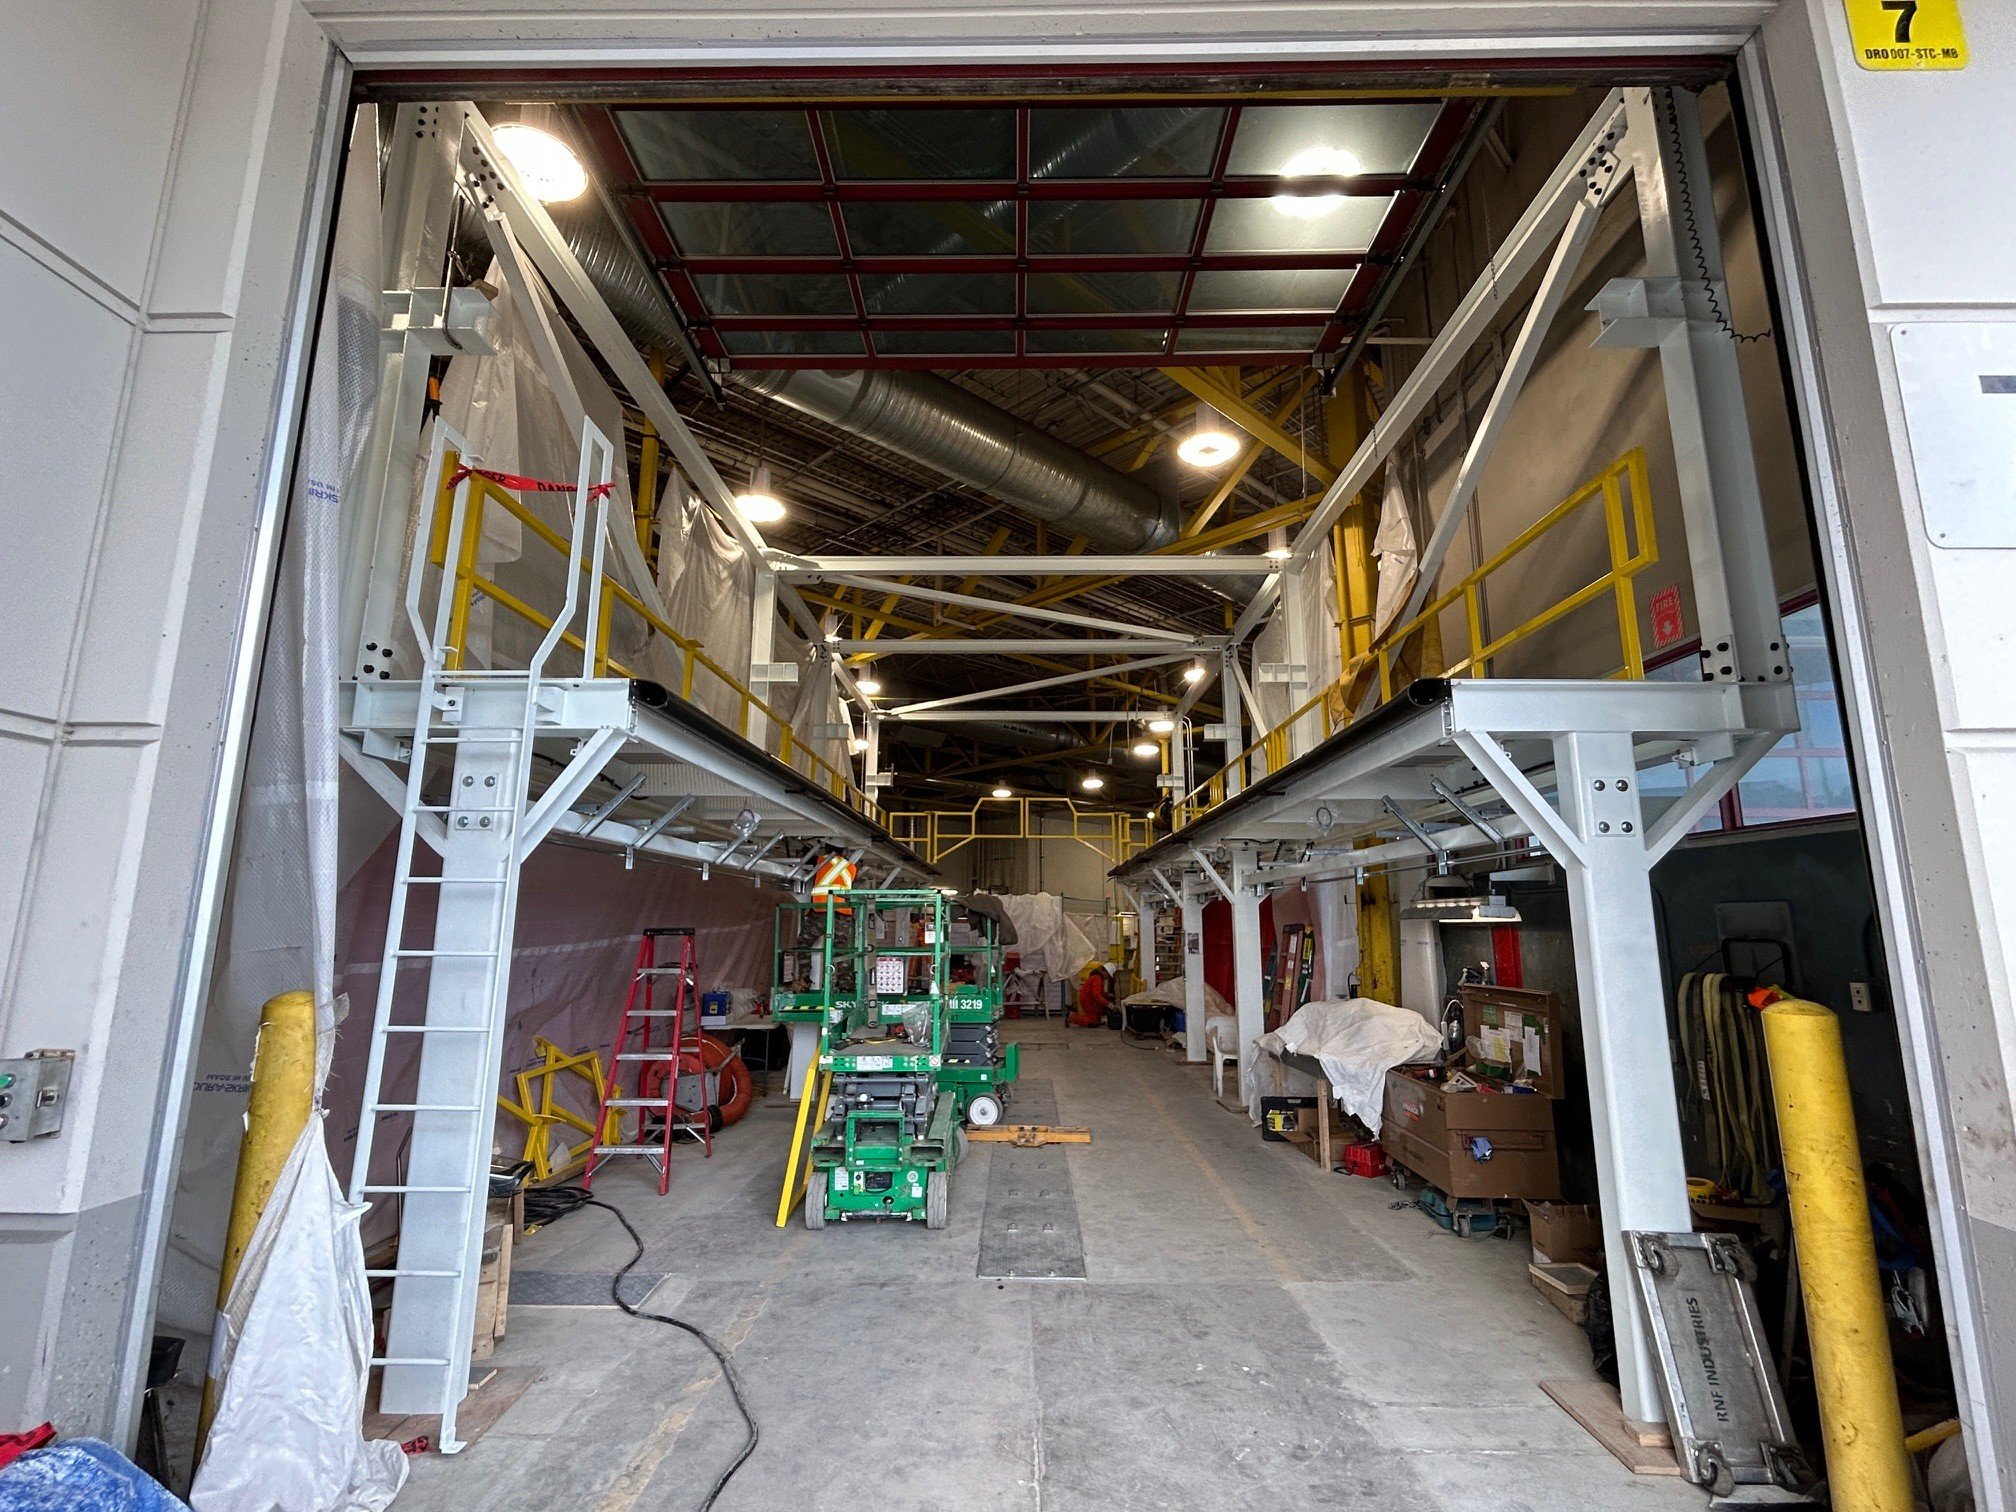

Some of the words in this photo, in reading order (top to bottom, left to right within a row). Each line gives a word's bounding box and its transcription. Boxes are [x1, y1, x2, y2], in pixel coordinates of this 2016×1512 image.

[1881, 1, 1917, 43] 7
[1656, 598, 1674, 612] FIRE
[960, 999, 983, 1009] 3219
[1686, 1297, 1720, 1386] INDUSTRIES
[1711, 1391, 1730, 1422] RNF
